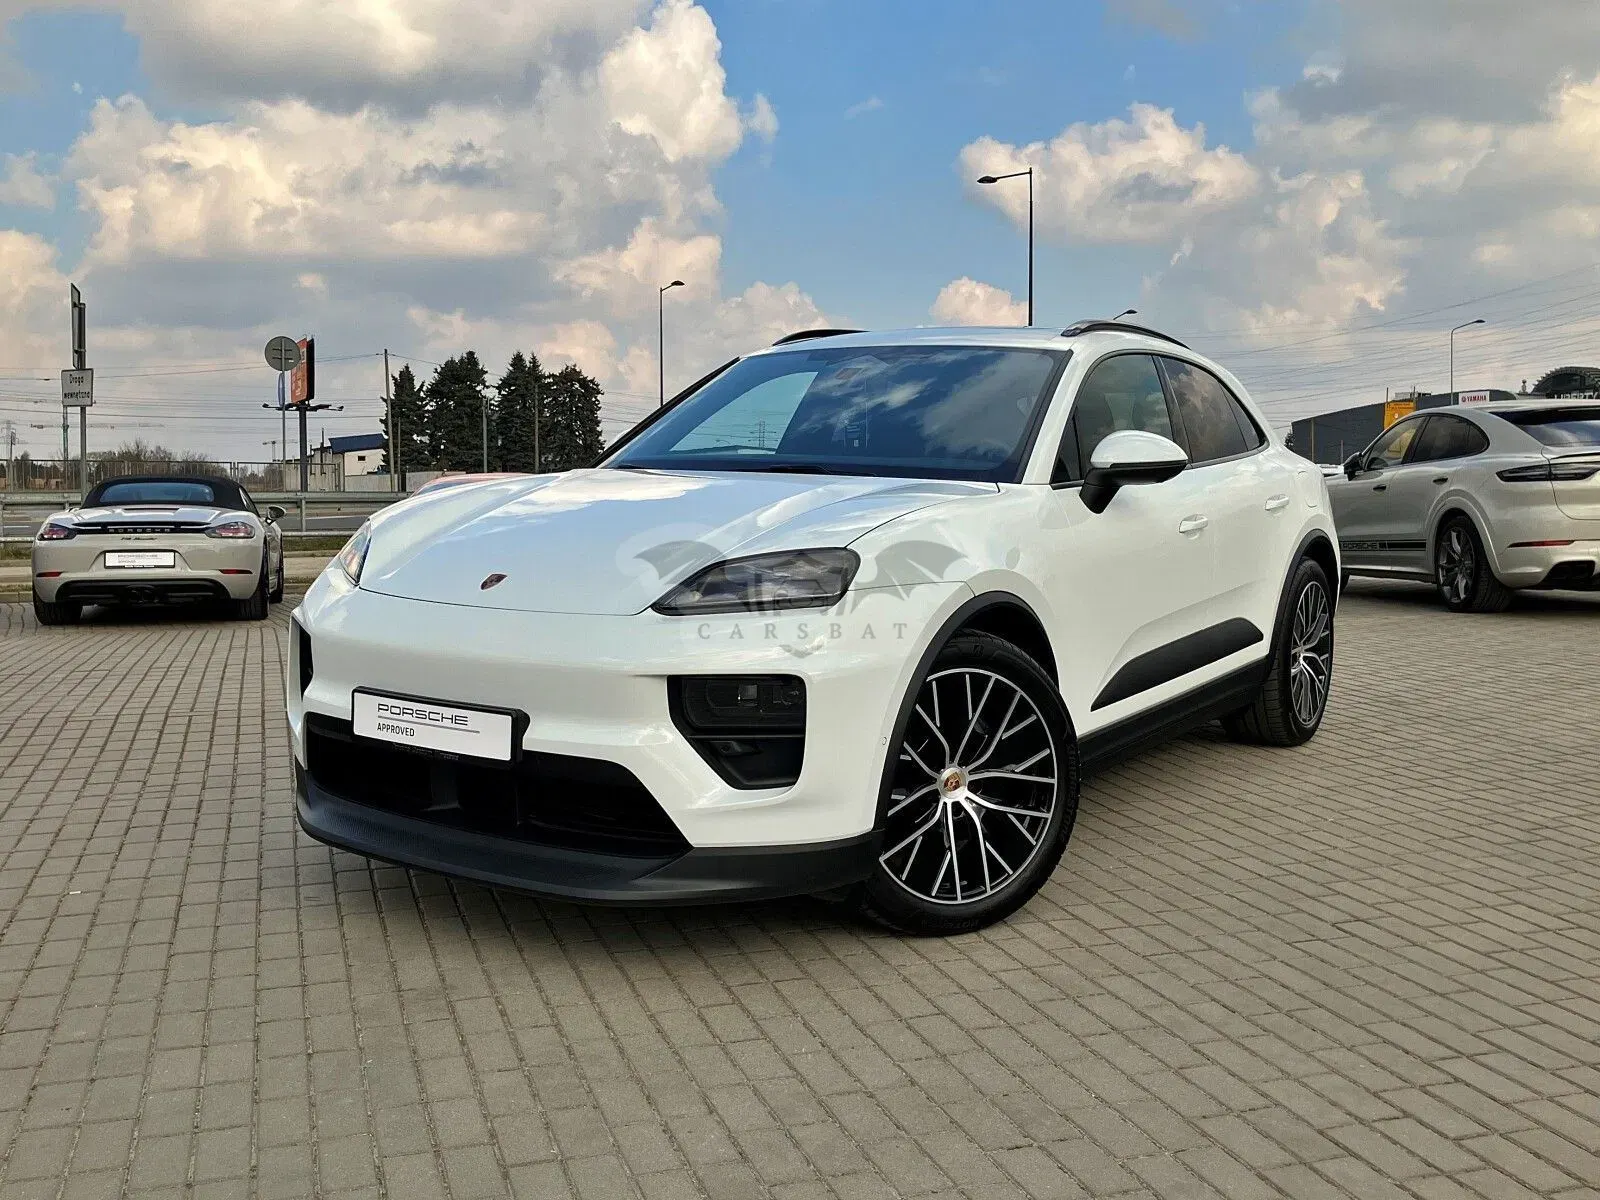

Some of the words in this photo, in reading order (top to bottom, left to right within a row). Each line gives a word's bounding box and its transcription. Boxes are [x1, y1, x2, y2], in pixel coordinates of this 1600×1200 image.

[1466, 394, 1487, 402] YAMAHA
[377, 703, 469, 726] PORSCHE
[377, 722, 415, 737] APPROVED
